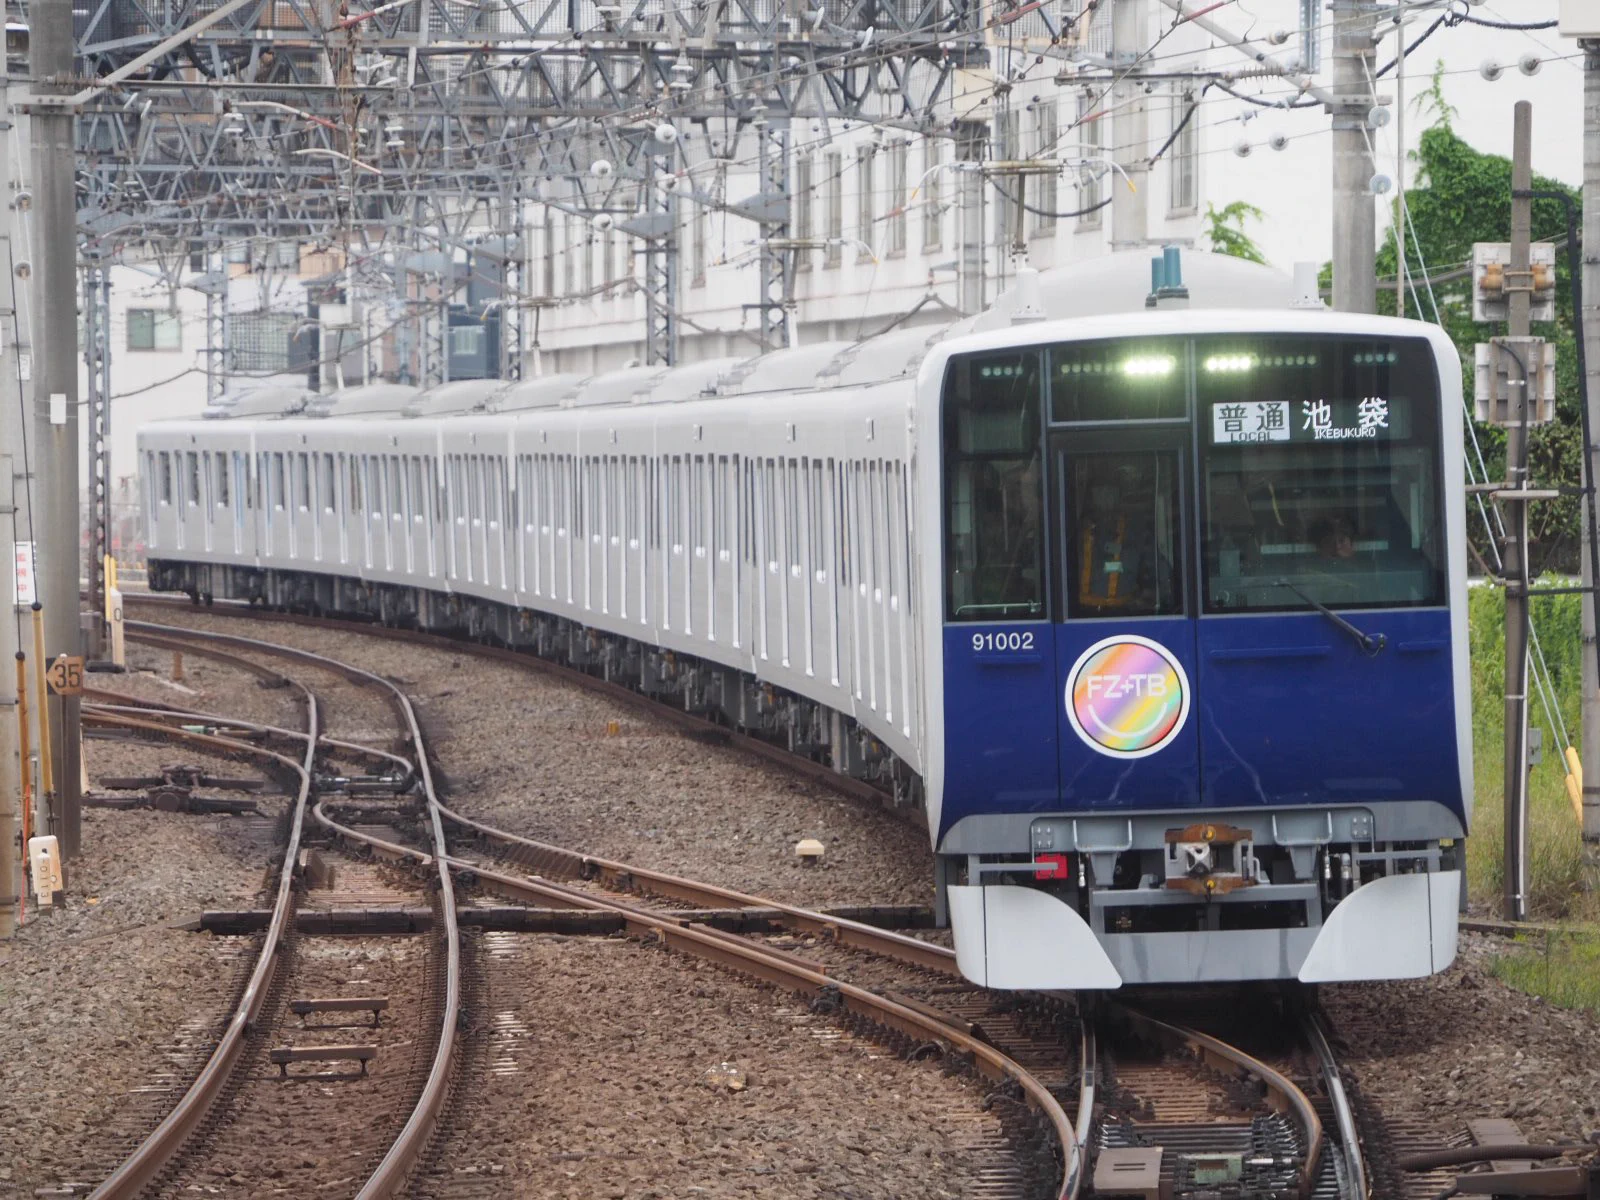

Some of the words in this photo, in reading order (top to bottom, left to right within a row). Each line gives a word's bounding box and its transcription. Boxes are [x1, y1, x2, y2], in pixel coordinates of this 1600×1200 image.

[1219, 403, 1284, 432] 普通
[1302, 397, 1389, 430] 池袋
[1230, 430, 1275, 443] LOCAL
[1314, 427, 1377, 440] IKEBUKURO
[972, 632, 1034, 650] 91002
[55, 663, 80, 688] 35
[1087, 673, 1167, 699] FZ+TB
